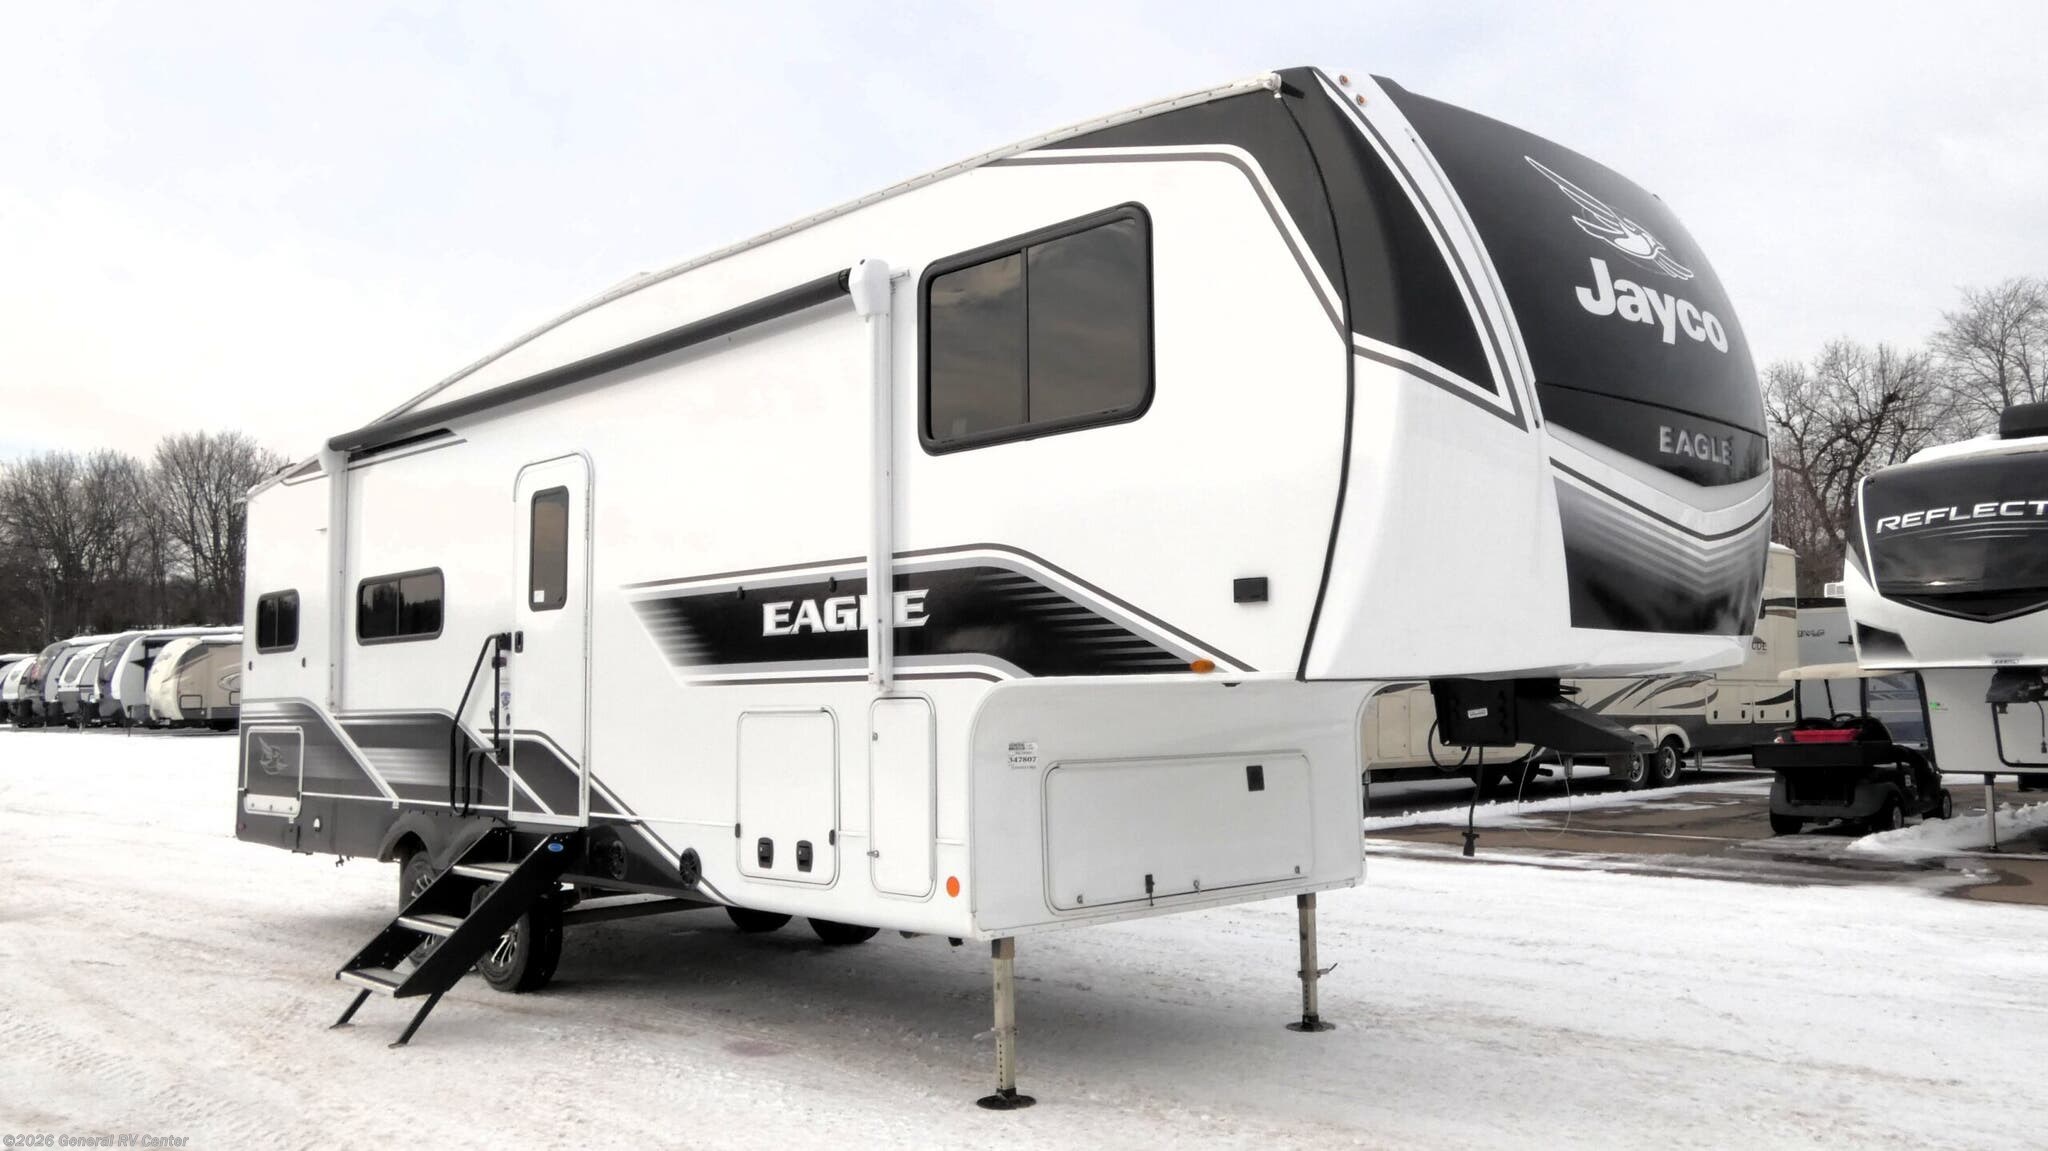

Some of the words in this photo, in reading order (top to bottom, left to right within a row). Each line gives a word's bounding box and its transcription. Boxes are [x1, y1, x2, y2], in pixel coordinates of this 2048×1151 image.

[1575, 257, 1728, 353] Jayco
[1659, 425, 1733, 466] EAGLE
[1876, 500, 2048, 534] REFLECT
